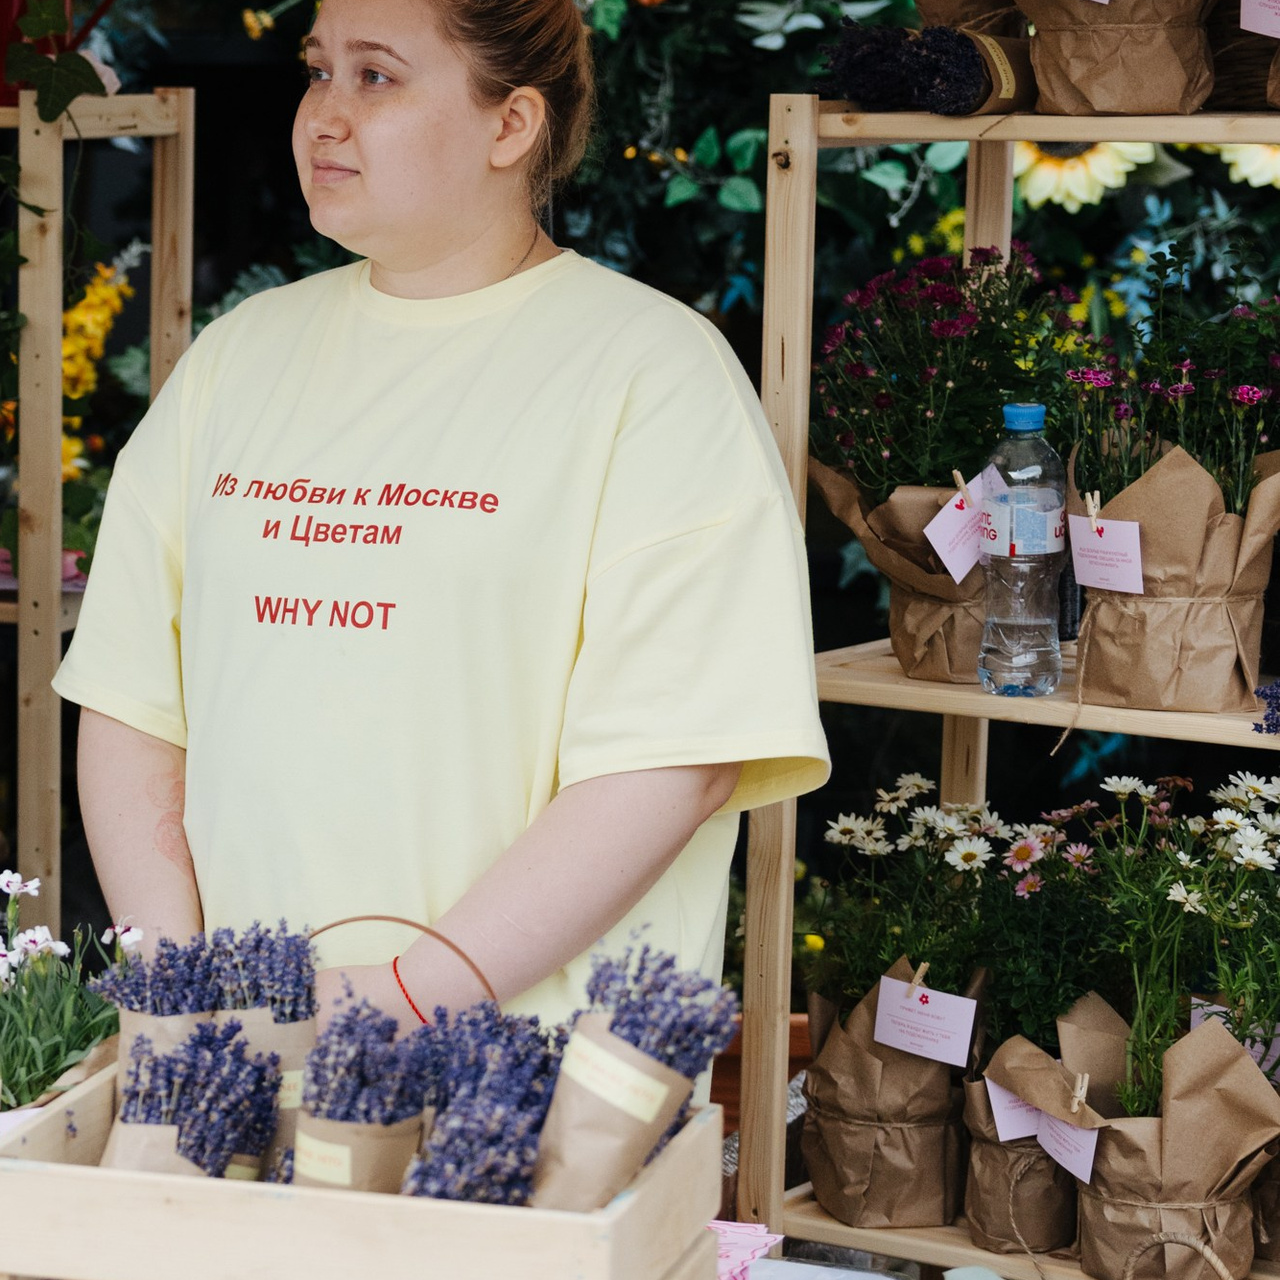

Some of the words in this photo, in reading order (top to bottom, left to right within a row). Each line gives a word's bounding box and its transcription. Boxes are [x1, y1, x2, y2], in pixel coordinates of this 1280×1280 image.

[212, 472, 238, 498] Из
[243, 478, 345, 506] любви
[353, 487, 372, 506] к
[378, 483, 500, 514] Москве
[262, 519, 281, 539] и
[290, 515, 403, 547] Цветам
[254, 596, 323, 627] WHY
[329, 600, 397, 630] NOT
